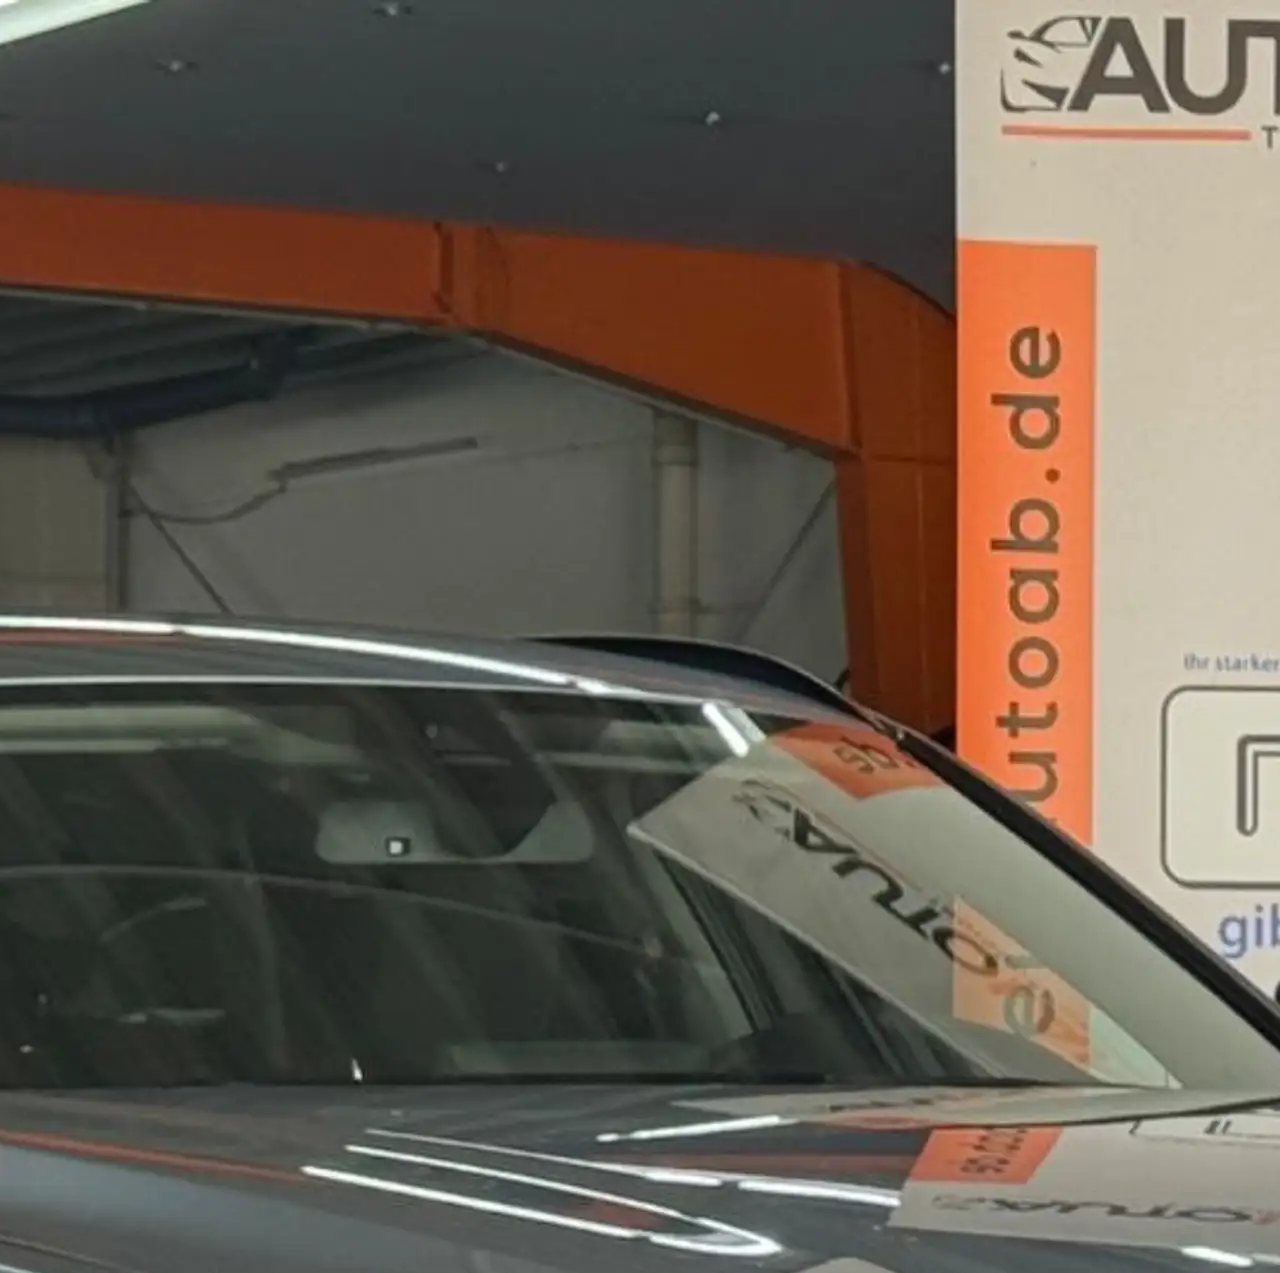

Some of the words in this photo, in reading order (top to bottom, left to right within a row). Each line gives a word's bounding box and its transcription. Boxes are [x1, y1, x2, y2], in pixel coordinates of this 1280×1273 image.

[990, 326, 1062, 826] utoab.de
[1183, 653, 1210, 671] Ihr
[1216, 655, 1279, 673] starker
